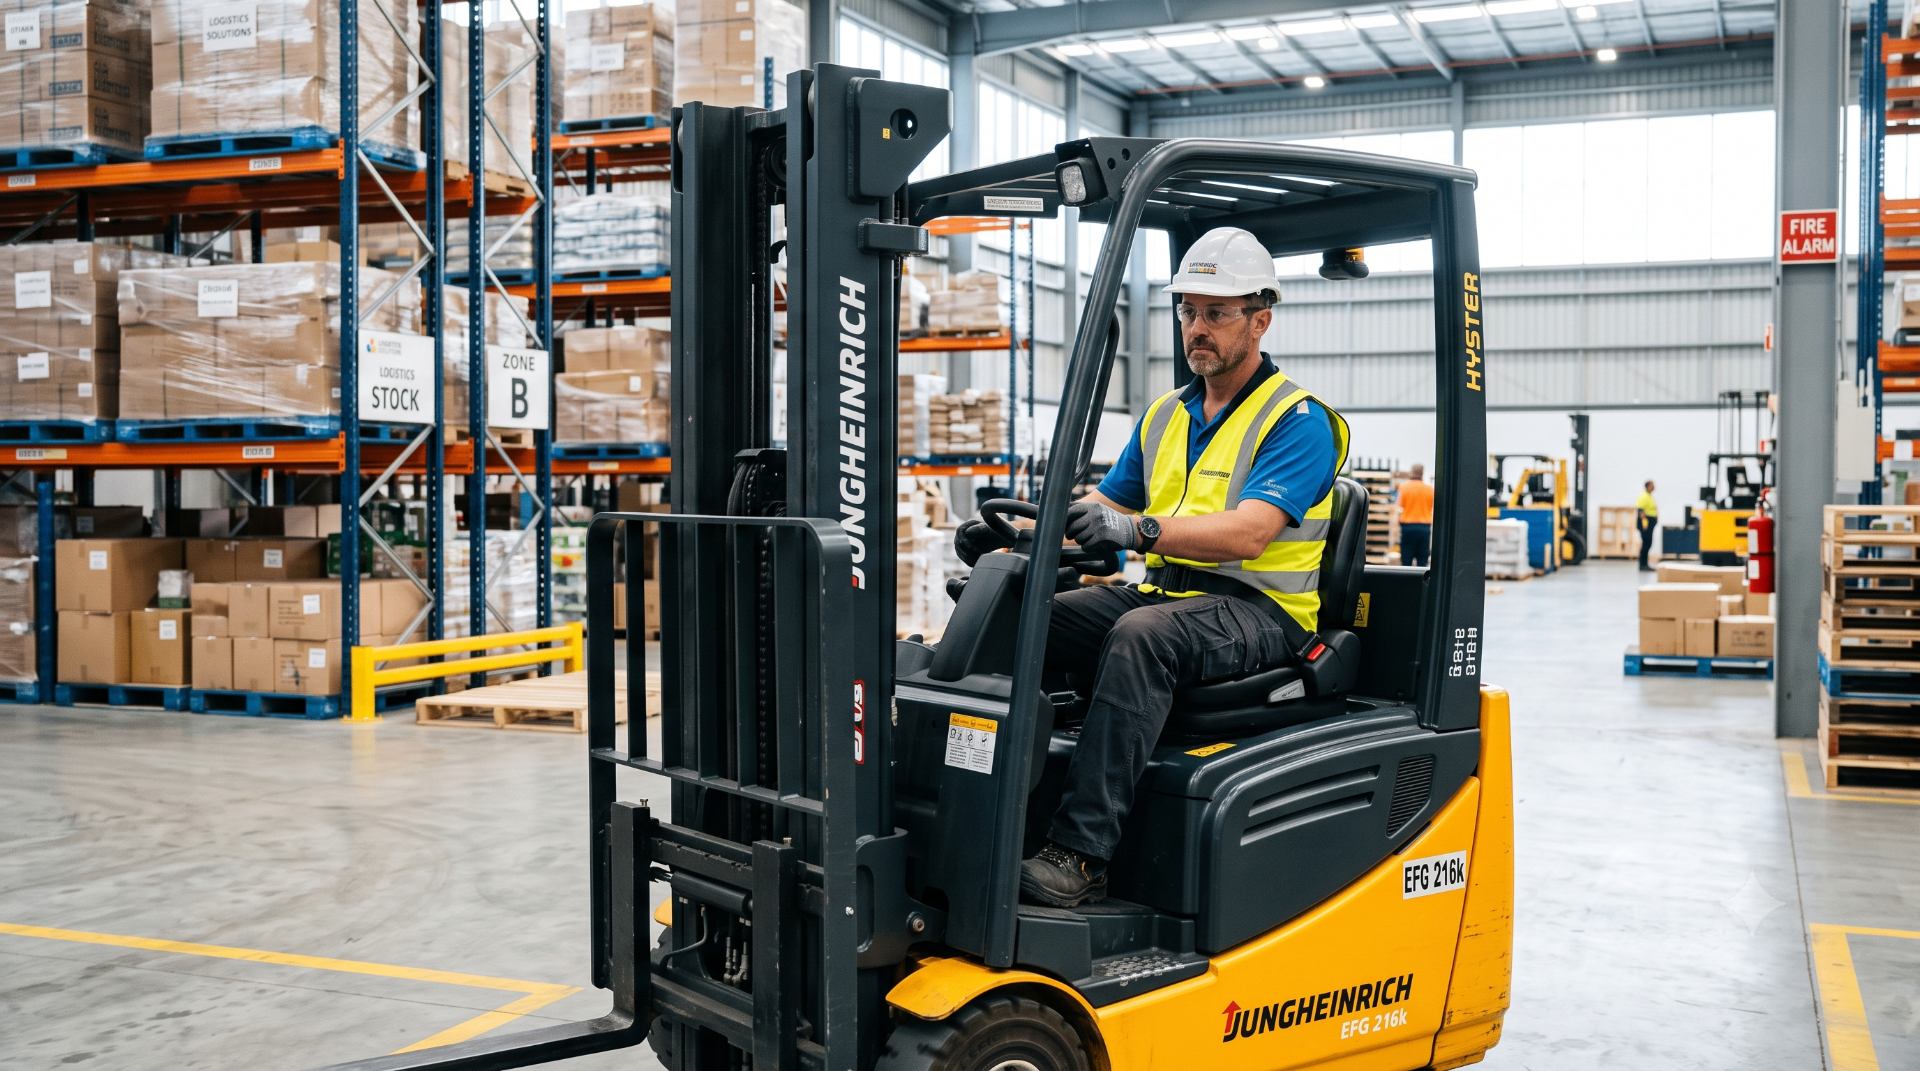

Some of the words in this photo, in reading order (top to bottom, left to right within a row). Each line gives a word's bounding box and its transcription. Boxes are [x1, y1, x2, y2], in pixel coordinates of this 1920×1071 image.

[209, 14, 249, 27] LOGISTICS
[207, 27, 252, 40] SOLUTIONS
[1790, 218, 1827, 235] FIRE
[1782, 237, 1835, 255] ALARM
[1464, 272, 1481, 392] HYSTER
[380, 366, 415, 380] LOGISTICS
[503, 353, 535, 371] ZONE
[372, 386, 420, 411] STOCK
[511, 377, 529, 419] B
[839, 276, 866, 590] JUNGHEINRICH
[1404, 863, 1429, 893] EFG
[1433, 857, 1465, 888] 216k
[1222, 973, 1414, 1043] JUNGHEINRICH
[1340, 1016, 1370, 1040] EFG
[1372, 1008, 1408, 1033] 216k
